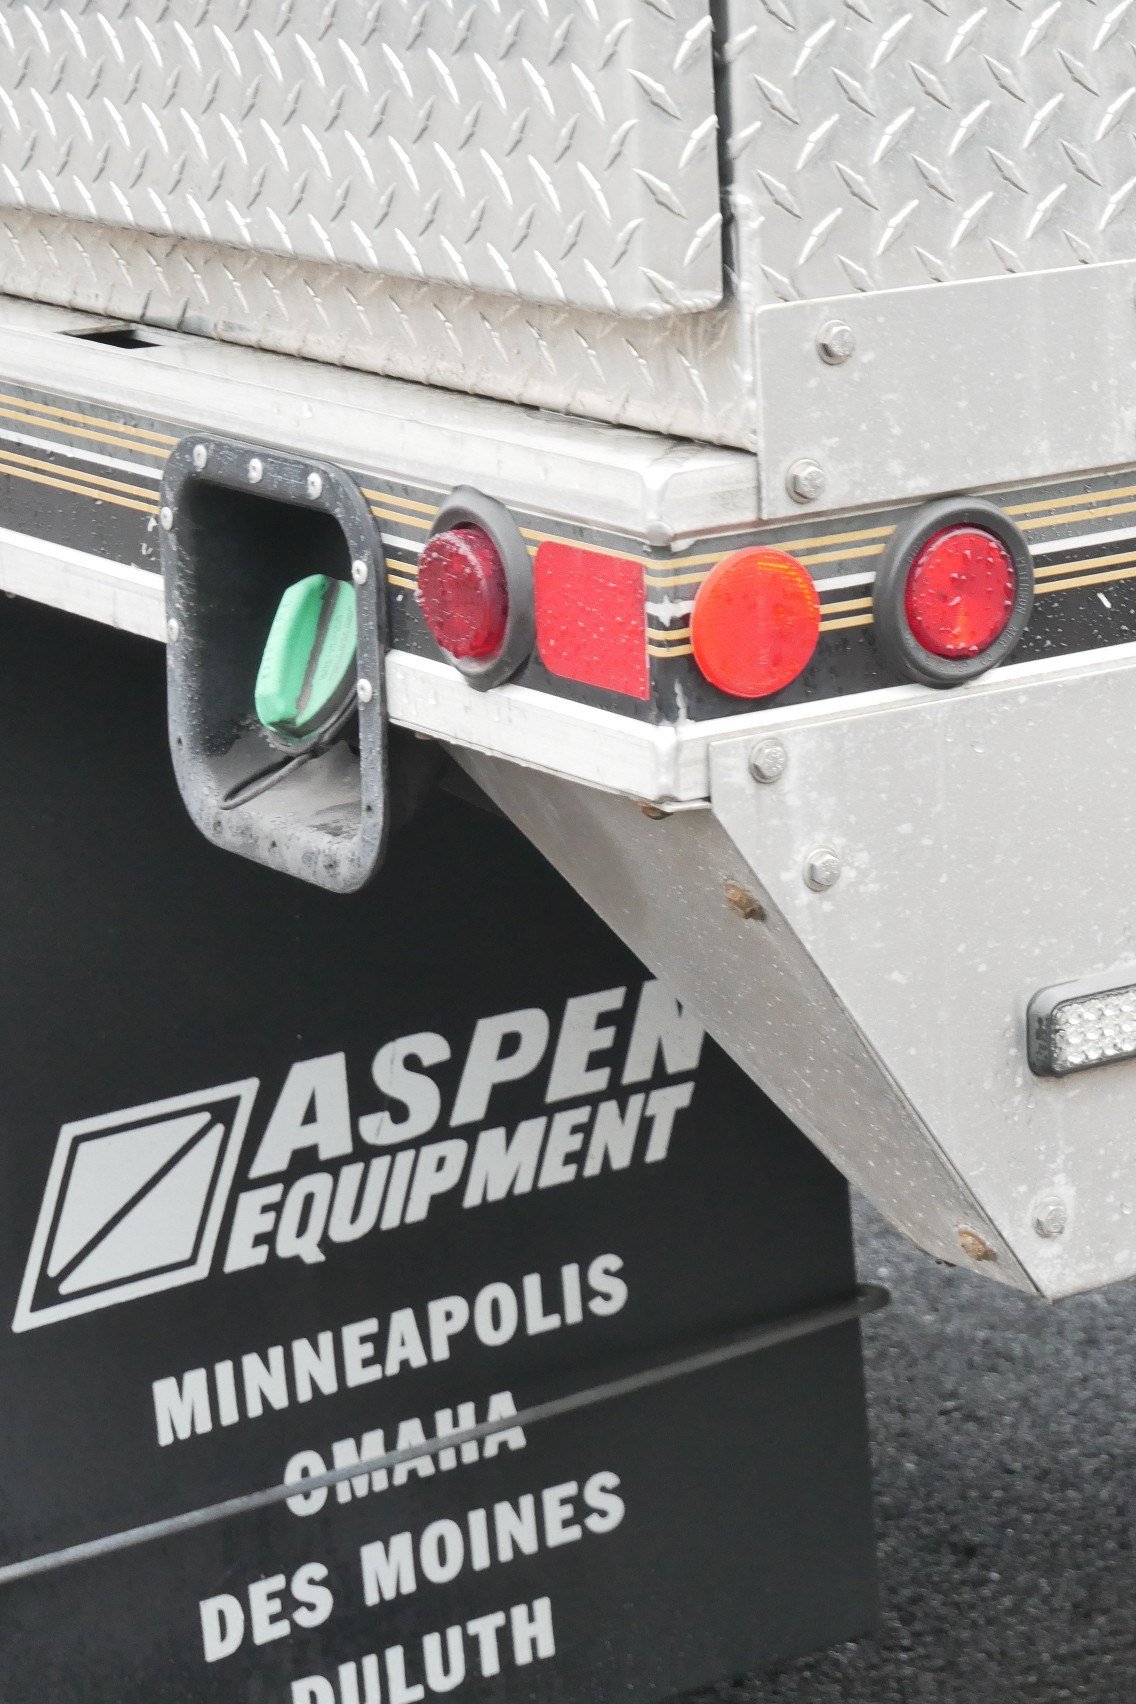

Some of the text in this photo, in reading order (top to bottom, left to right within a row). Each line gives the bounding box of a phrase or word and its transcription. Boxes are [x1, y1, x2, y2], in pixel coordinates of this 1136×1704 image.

[247, 978, 706, 1180] ASPEN
[223, 1081, 696, 1274] EQUIPMENT
[151, 1252, 629, 1448] MINNEAPOLIS
[283, 1390, 527, 1518] OMAHA
[199, 1470, 626, 1664] DES MOINES
